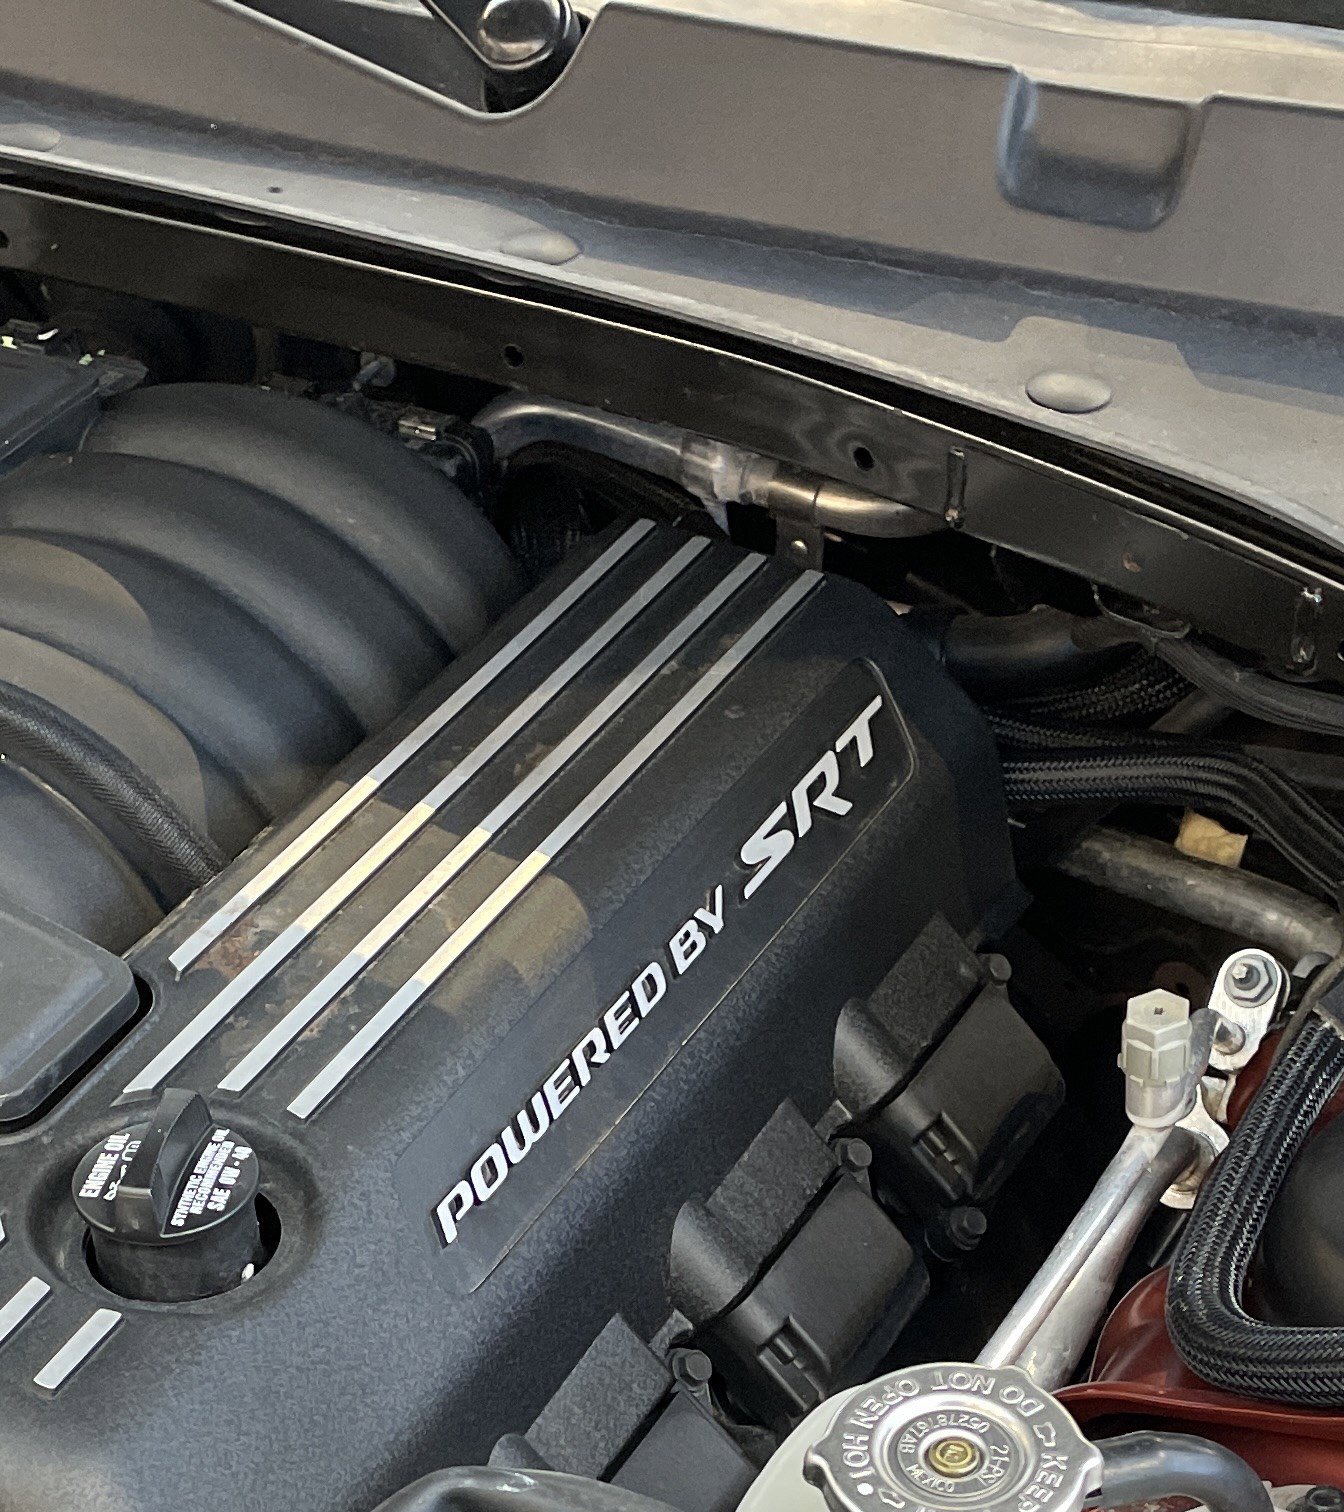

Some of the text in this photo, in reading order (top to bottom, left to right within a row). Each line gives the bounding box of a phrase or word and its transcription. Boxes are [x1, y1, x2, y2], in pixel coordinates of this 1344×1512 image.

[436, 695, 883, 1244] POWERED BY SRT
[79, 1133, 130, 1198] ENGINE OIL
[189, 1141, 235, 1215] RECOMMENDED
[207, 1187, 231, 1212] SAE
[170, 1174, 202, 1227] SYNTHETIC
[842, 1371, 1044, 1478] DO NOT OPEN HOT
